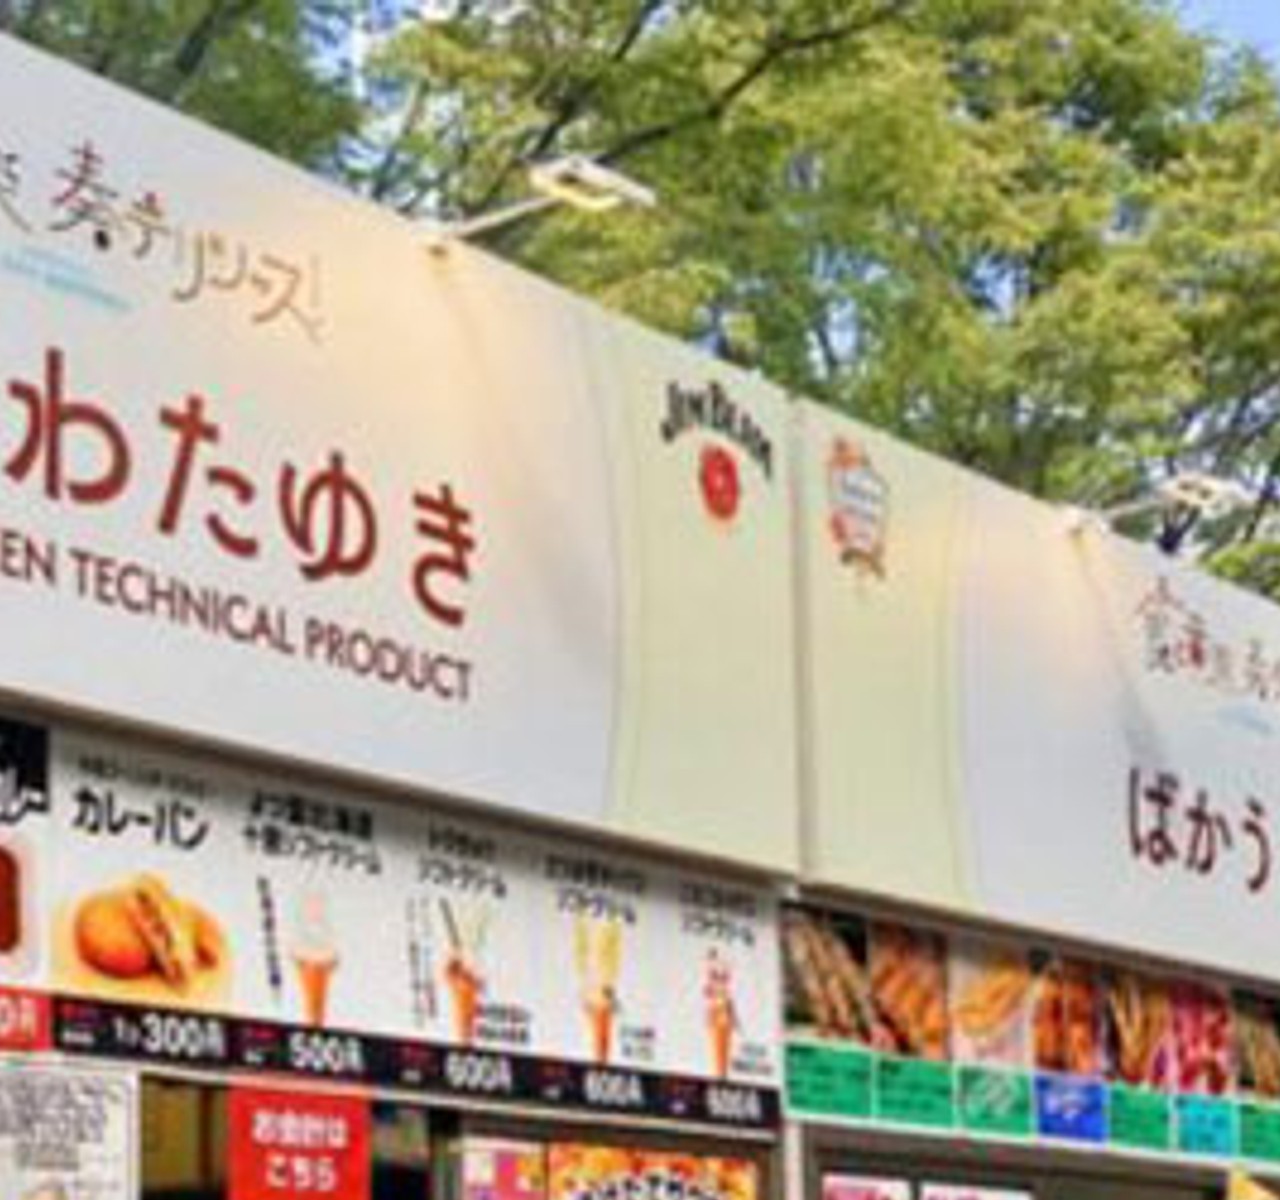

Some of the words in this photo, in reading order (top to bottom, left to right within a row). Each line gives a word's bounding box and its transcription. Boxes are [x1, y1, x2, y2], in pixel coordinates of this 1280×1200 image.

[68, 546, 297, 654] TECHNICAL
[304, 617, 474, 703] PRODUCT
[72, 785, 210, 850] カレーパン
[266, 1153, 337, 1191] こちら
